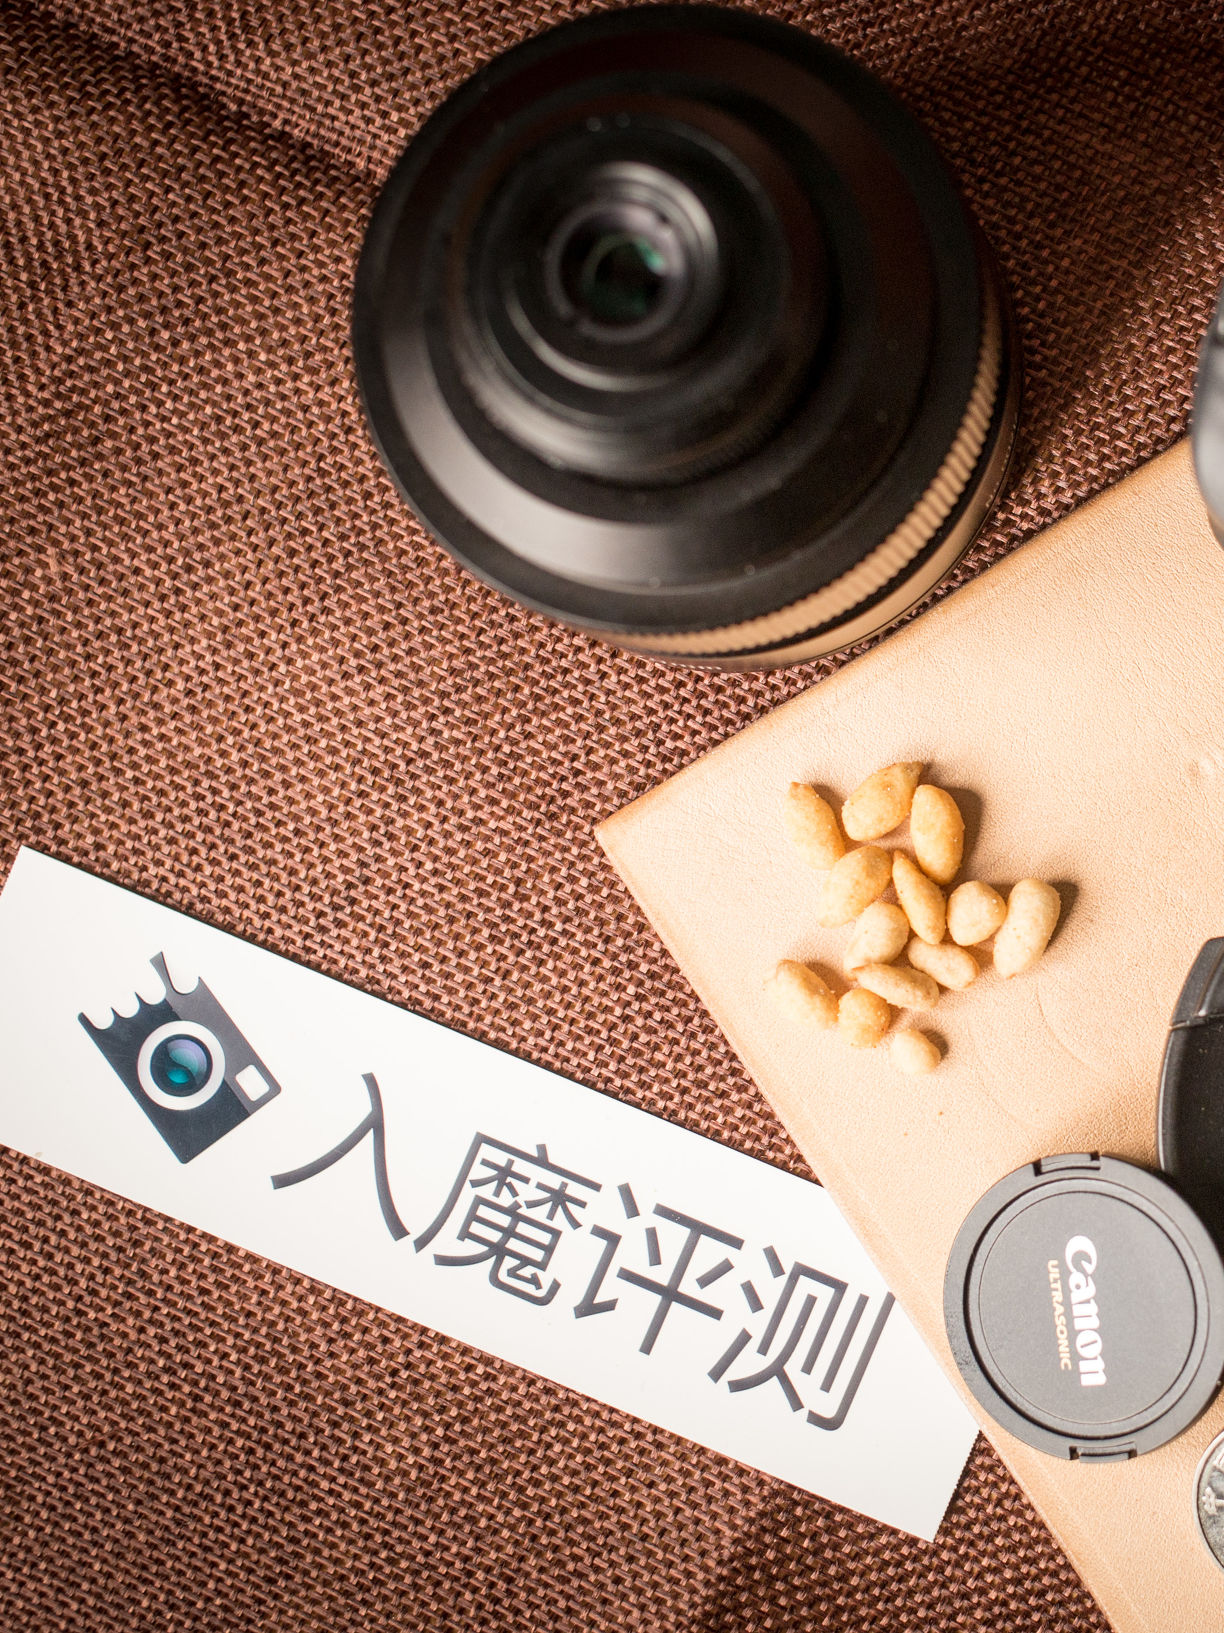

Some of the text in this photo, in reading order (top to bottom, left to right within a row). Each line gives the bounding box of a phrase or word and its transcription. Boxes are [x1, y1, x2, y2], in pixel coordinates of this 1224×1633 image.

[271, 1073, 895, 1431] 入魔评测
[1048, 1260, 1072, 1371] ULTRASONIC
[1065, 1235, 1107, 1386] Canon
